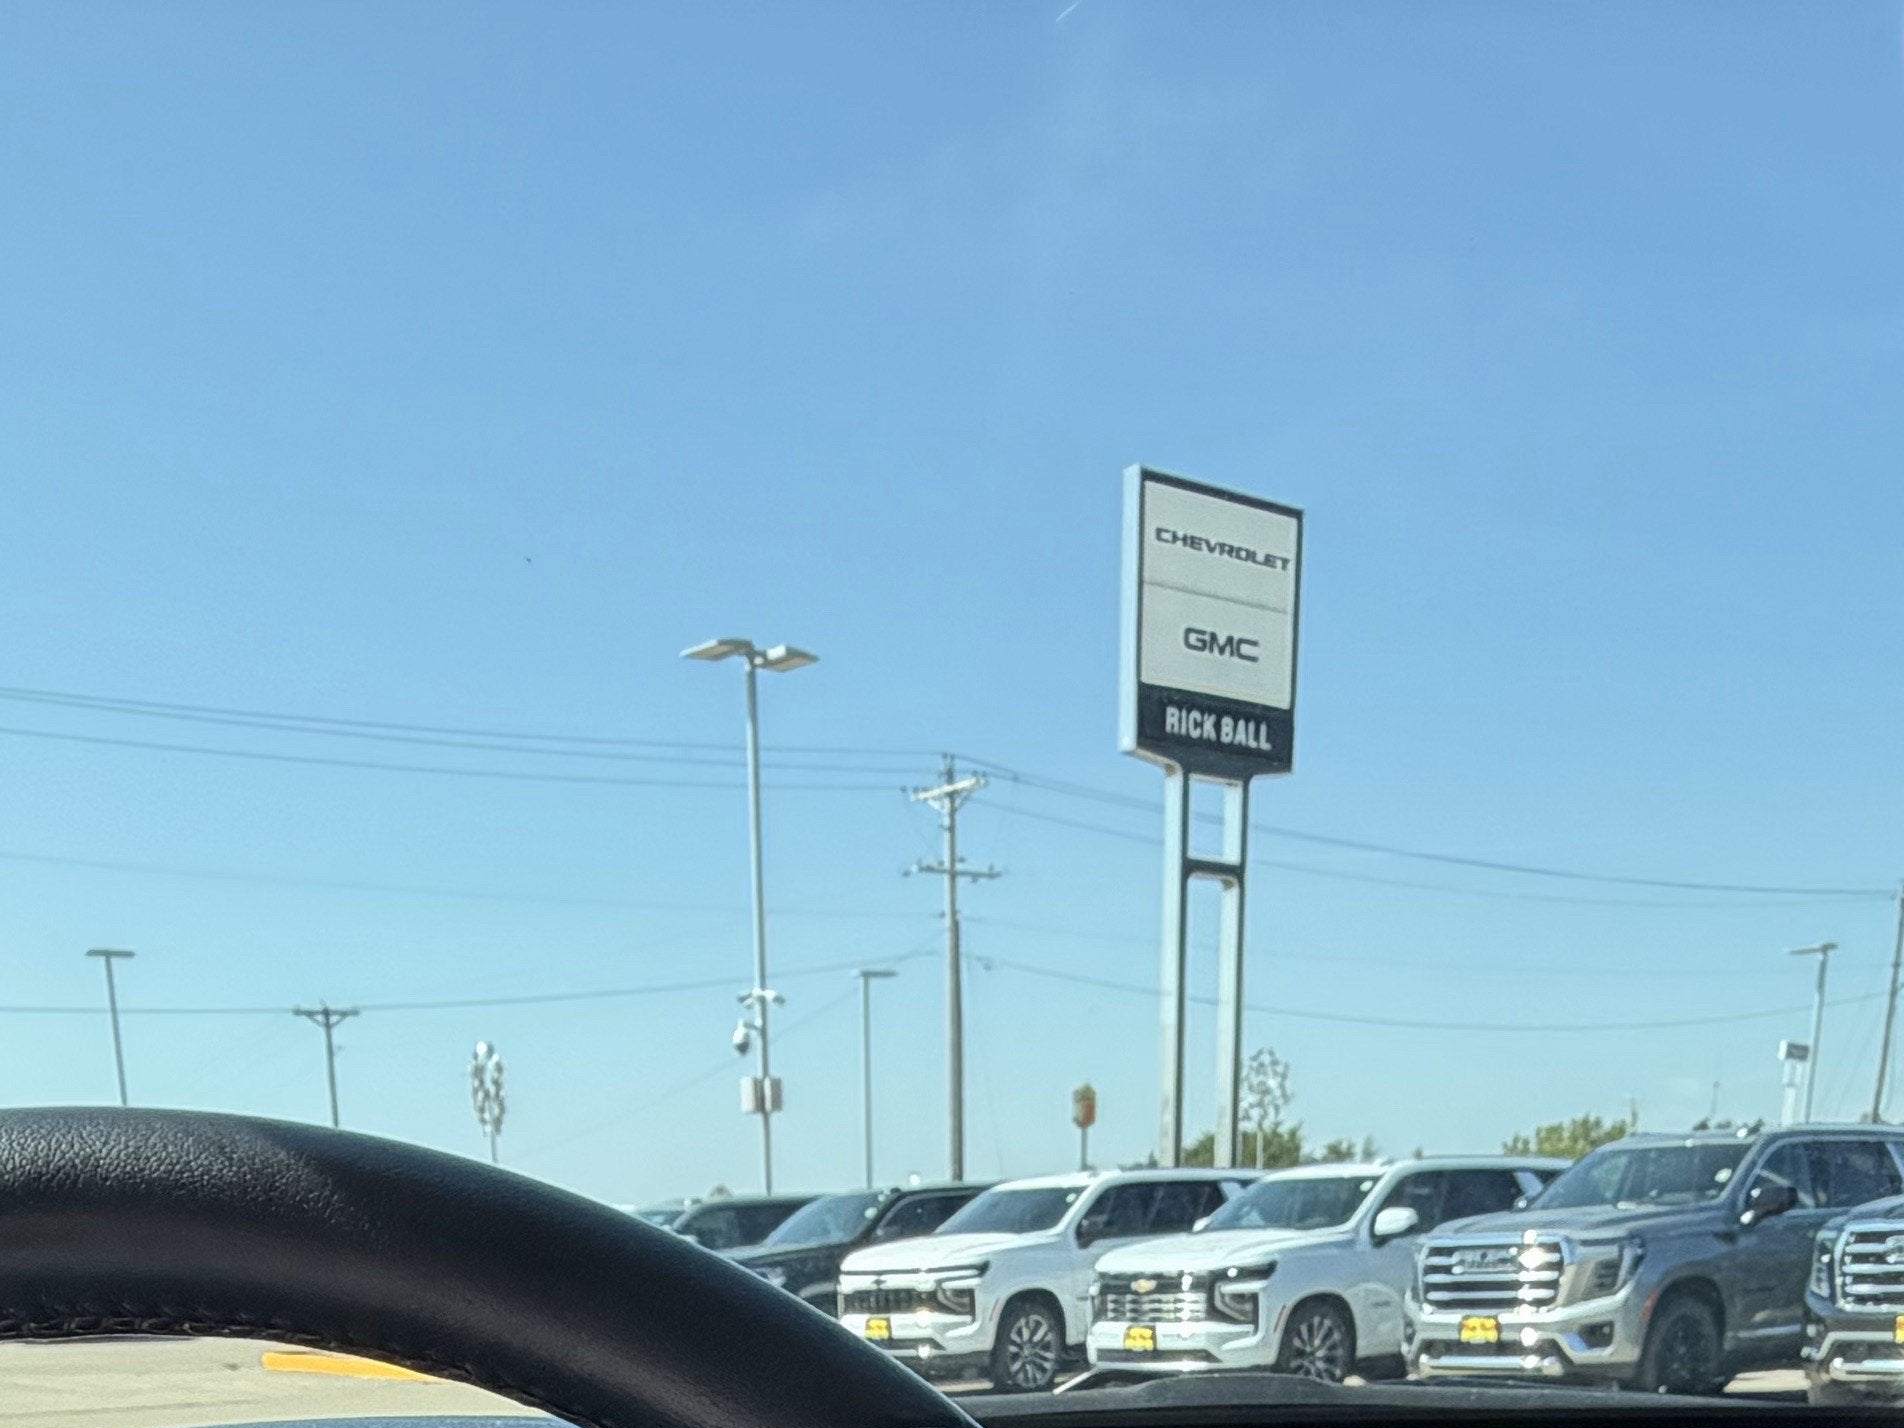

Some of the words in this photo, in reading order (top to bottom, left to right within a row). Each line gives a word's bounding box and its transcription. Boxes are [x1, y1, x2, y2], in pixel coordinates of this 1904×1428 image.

[1155, 526, 1291, 571] CHEVROLET
[1183, 626, 1260, 663] GMC
[1165, 705, 1218, 742] RICK
[1220, 715, 1273, 751] BALL
